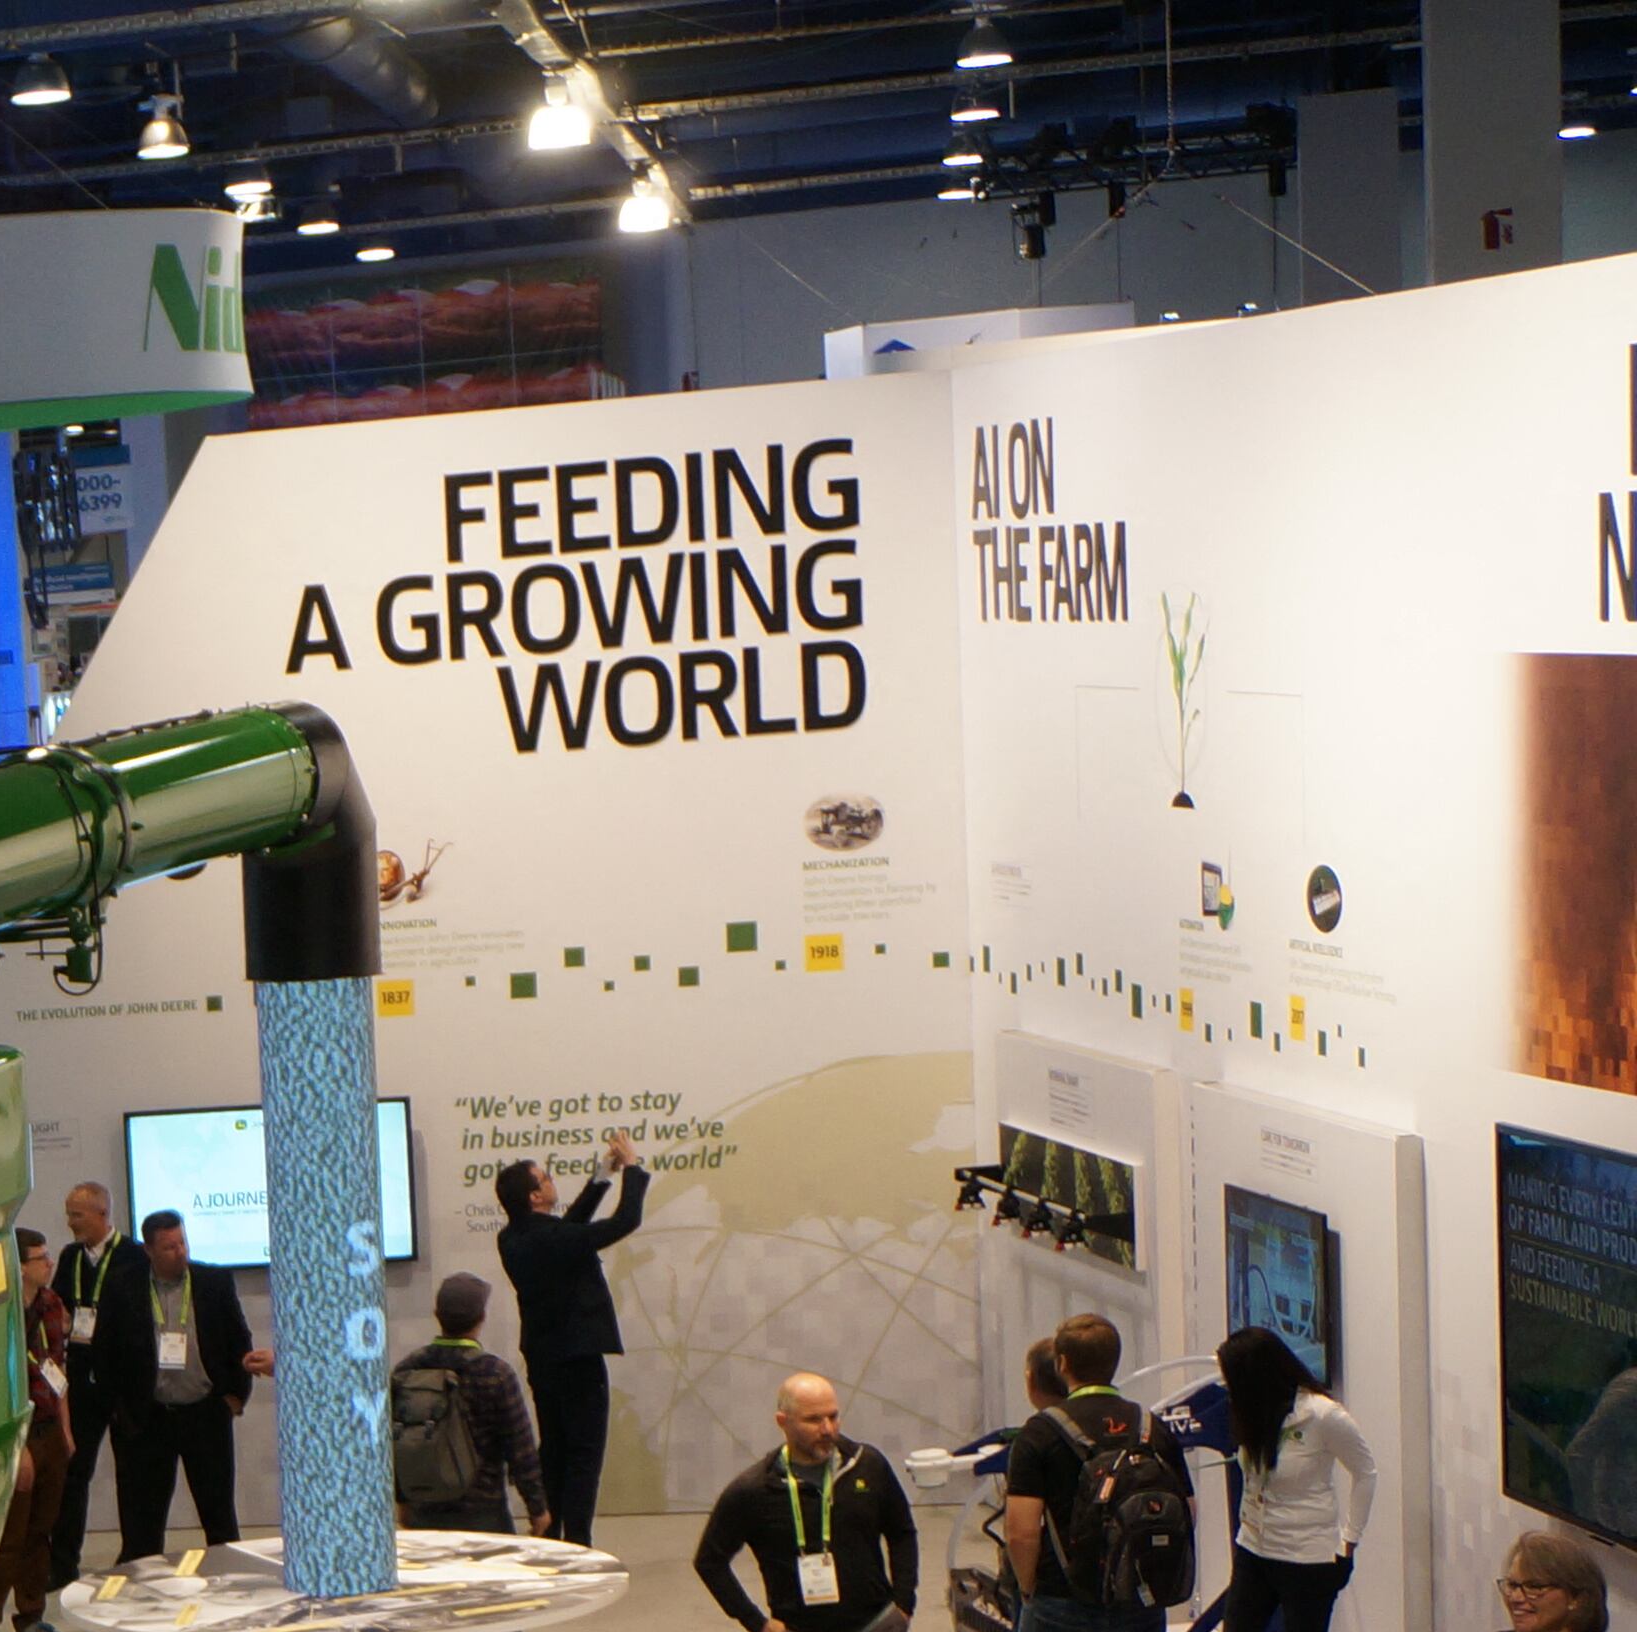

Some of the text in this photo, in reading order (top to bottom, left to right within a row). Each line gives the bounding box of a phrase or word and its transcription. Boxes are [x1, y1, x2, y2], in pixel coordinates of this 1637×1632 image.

[972, 416, 1055, 520] AI ON
[443, 438, 861, 564] FEEDING
[973, 521, 1128, 623] THE FARM
[285, 538, 864, 675] A GROWING
[496, 640, 867, 755] WORLD
[802, 856, 890, 871] MECHANIZATION
[810, 945, 840, 959] 1918
[16, 999, 199, 1022] THE EVOLUTION OF JOHN DEERE
[381, 990, 411, 1005] 1837
[548, 1094, 590, 1122] got
[597, 1091, 623, 1113] to
[630, 1089, 682, 1117] stay
[462, 1128, 483, 1150] in
[490, 1124, 594, 1149] business
[654, 1116, 725, 1140] we’ve
[464, 1158, 507, 1188] got
[544, 1151, 598, 1176] feed
[192, 1193, 204, 1210] A
[465, 1203, 495, 1218] Chris
[1508, 1172, 1556, 1210] MAKING
[1559, 1185, 1598, 1218] EVERY
[1508, 1203, 1525, 1231] OF
[1528, 1208, 1599, 1254] FARMLAND
[1509, 1244, 1602, 1294] AND FEEDING A
[1509, 1273, 1637, 1337] SUSTAINABLE WORL
[344, 1219, 388, 1444] SOY
